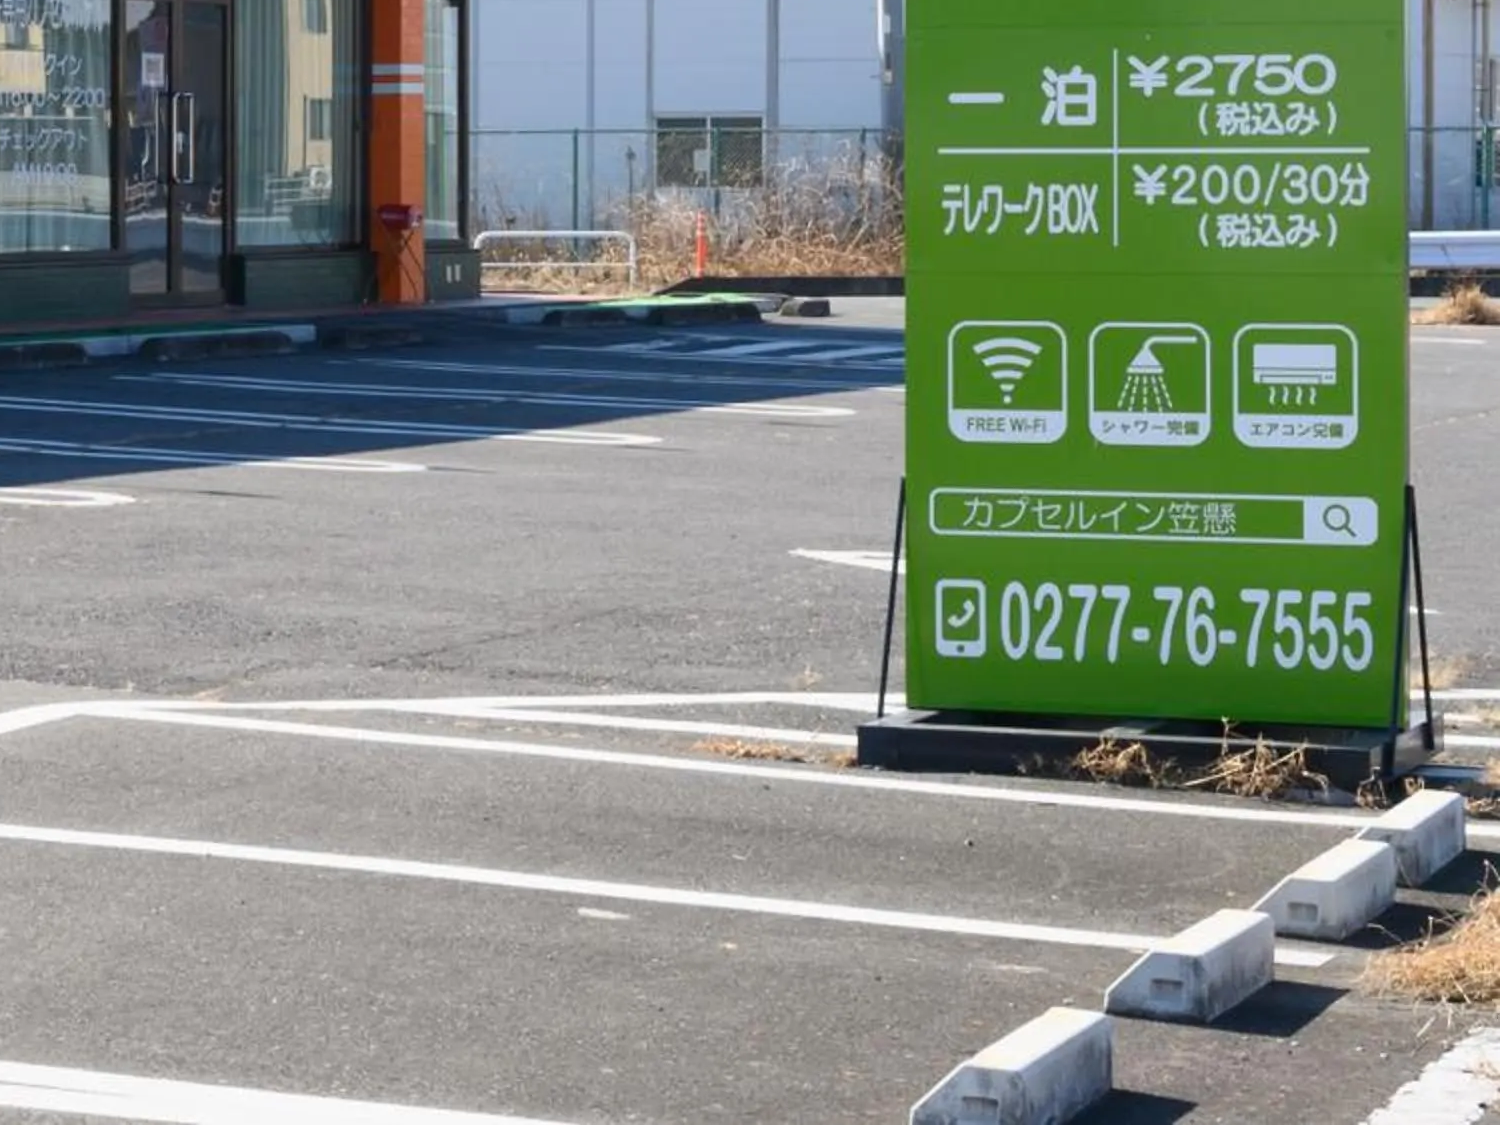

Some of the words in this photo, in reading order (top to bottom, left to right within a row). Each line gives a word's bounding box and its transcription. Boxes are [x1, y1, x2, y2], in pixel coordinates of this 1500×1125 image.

[1127, 53, 1337, 98] ¥2750
[1133, 162, 1371, 207] ¥200/30分
[941, 182, 1099, 236] テレワークBOX
[966, 417, 1006, 433] FREE
[1009, 418, 1047, 434] Wi-Fi
[1102, 420, 1200, 436] シャワー完備
[1249, 422, 1344, 439] エアコン完備
[962, 497, 1237, 536] カプセルイン笠懸
[1000, 580, 1374, 672] 0277-76-7555
